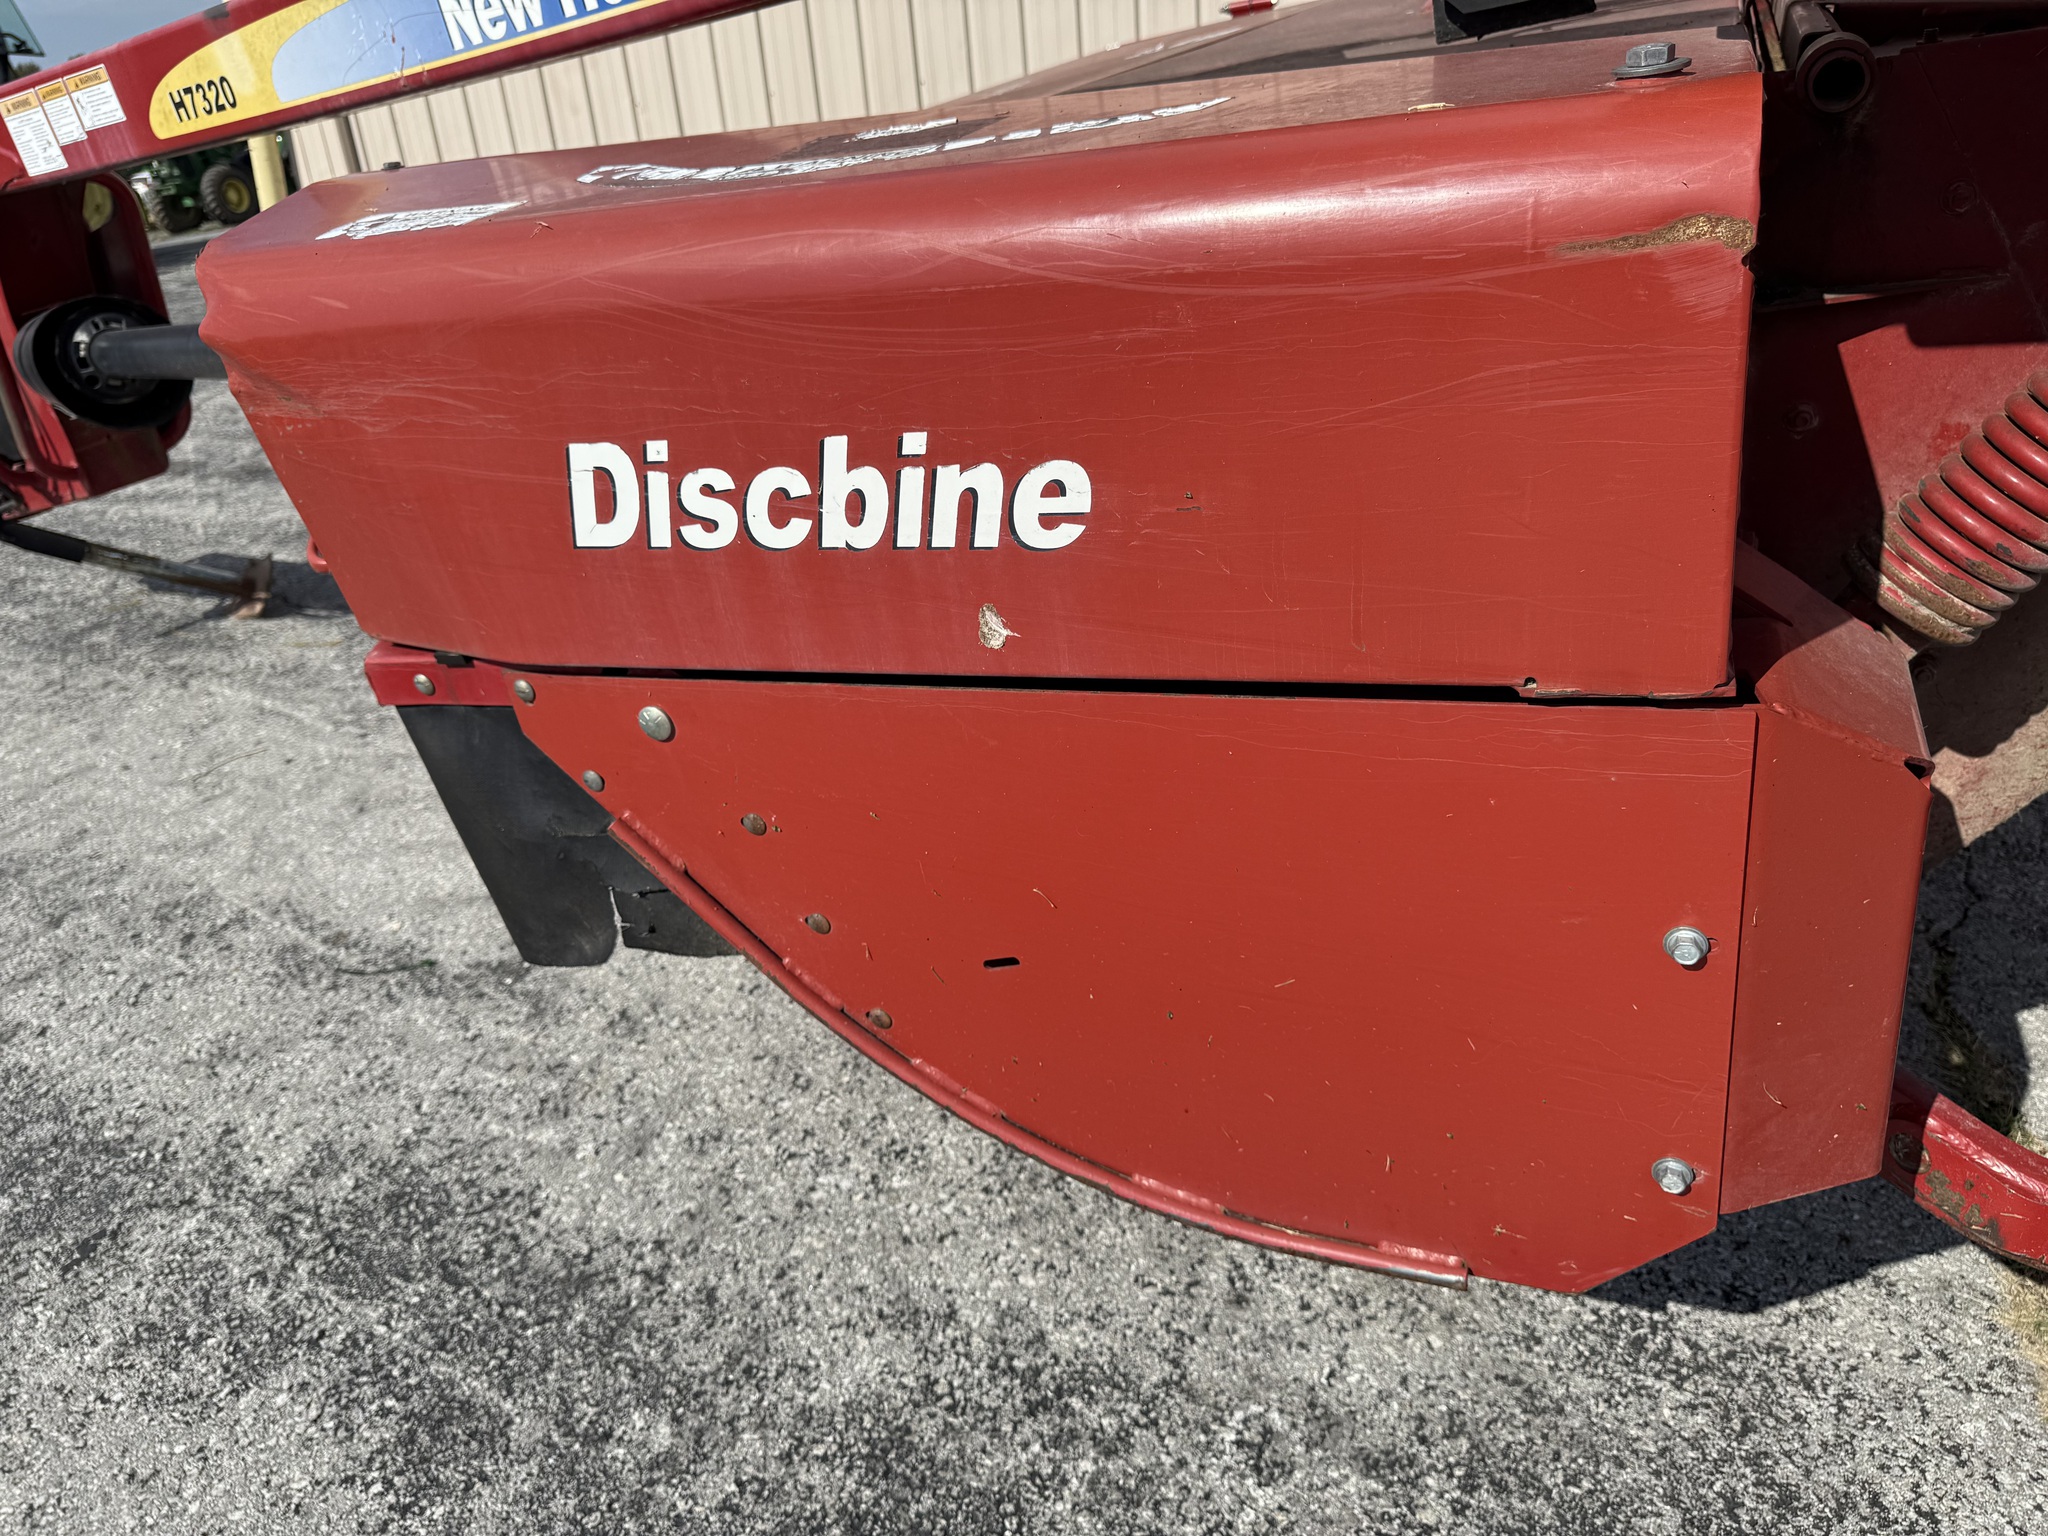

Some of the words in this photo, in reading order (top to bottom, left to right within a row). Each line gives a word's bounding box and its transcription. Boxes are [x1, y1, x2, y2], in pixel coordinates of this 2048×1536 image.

[437, 0, 544, 51] New
[168, 76, 237, 123] H7320
[566, 431, 1093, 551] Discbine
